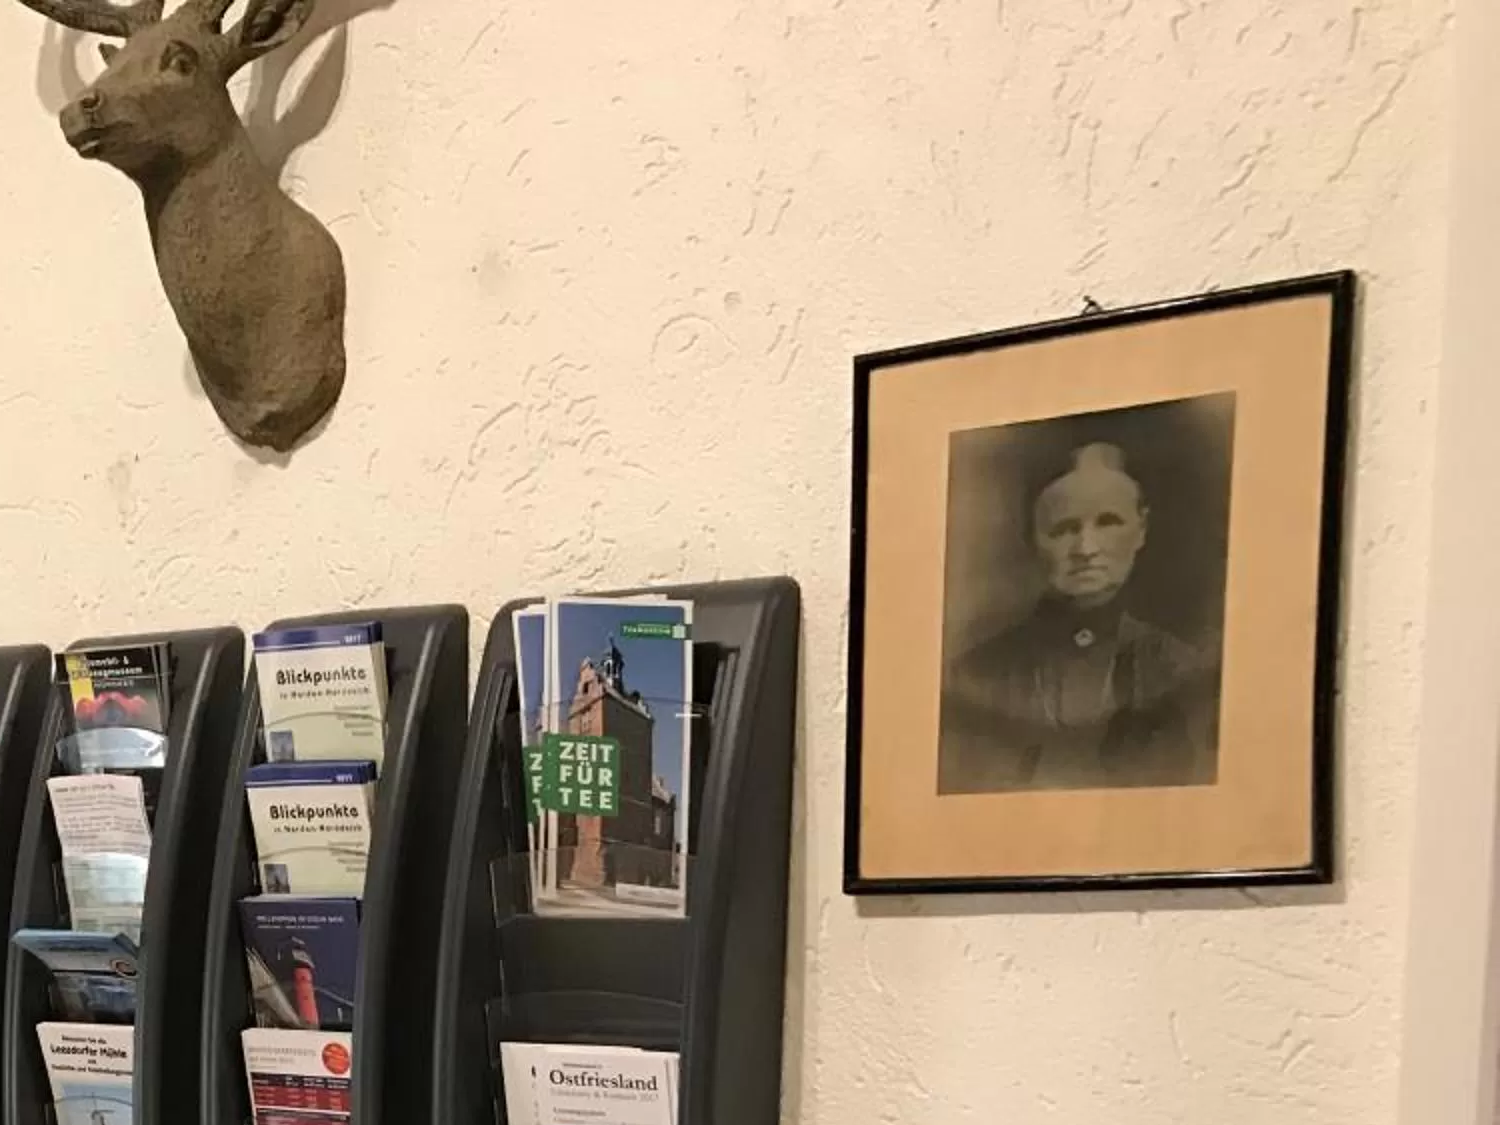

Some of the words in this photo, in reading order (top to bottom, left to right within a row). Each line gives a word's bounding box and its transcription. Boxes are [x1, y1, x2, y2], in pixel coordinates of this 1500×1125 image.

[275, 665, 367, 686] Blickpunkte
[558, 741, 613, 763] ZEIT
[559, 761, 613, 786] FÜR
[558, 787, 613, 810] TEE
[269, 803, 360, 822] Blickpunkte
[549, 1068, 658, 1091] Ostfriesland
